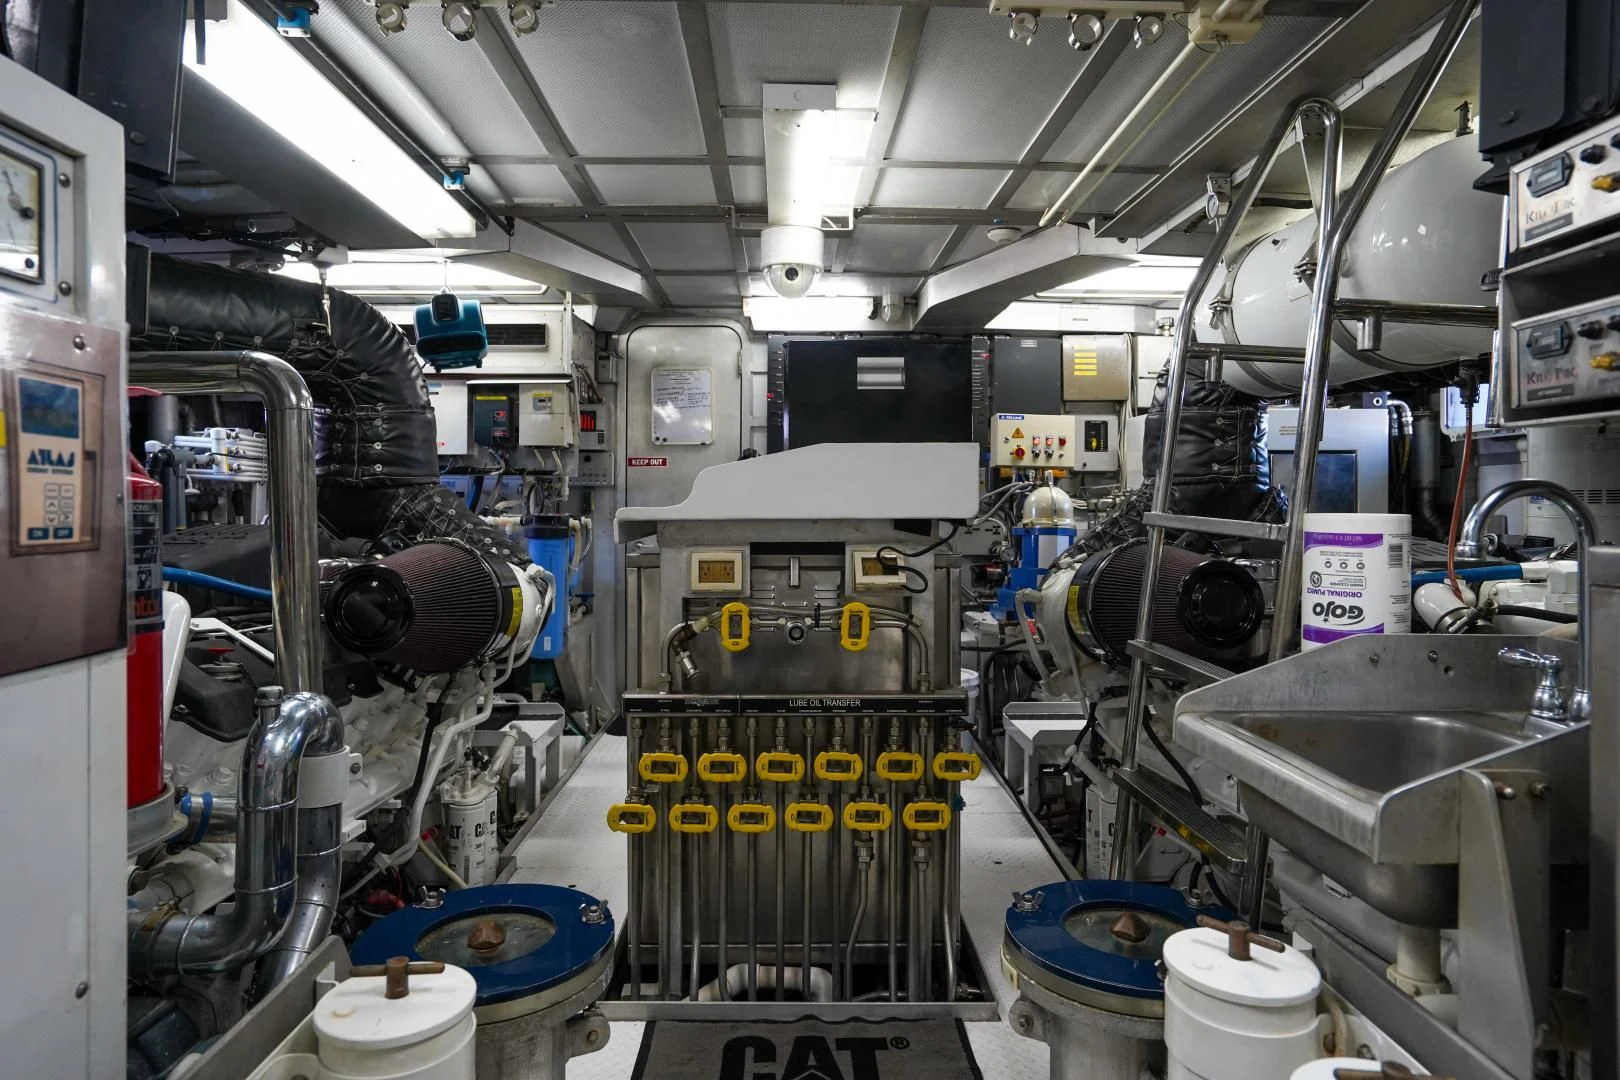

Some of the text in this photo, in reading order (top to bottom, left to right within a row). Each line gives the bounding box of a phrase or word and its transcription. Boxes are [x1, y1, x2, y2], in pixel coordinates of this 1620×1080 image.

[27, 448, 75, 467] ATLAS
[1326, 589, 1362, 598] ORIGINAL
[789, 699, 861, 707] LUBE OIL TRANSFER
[719, 1035, 889, 1080] CAT
